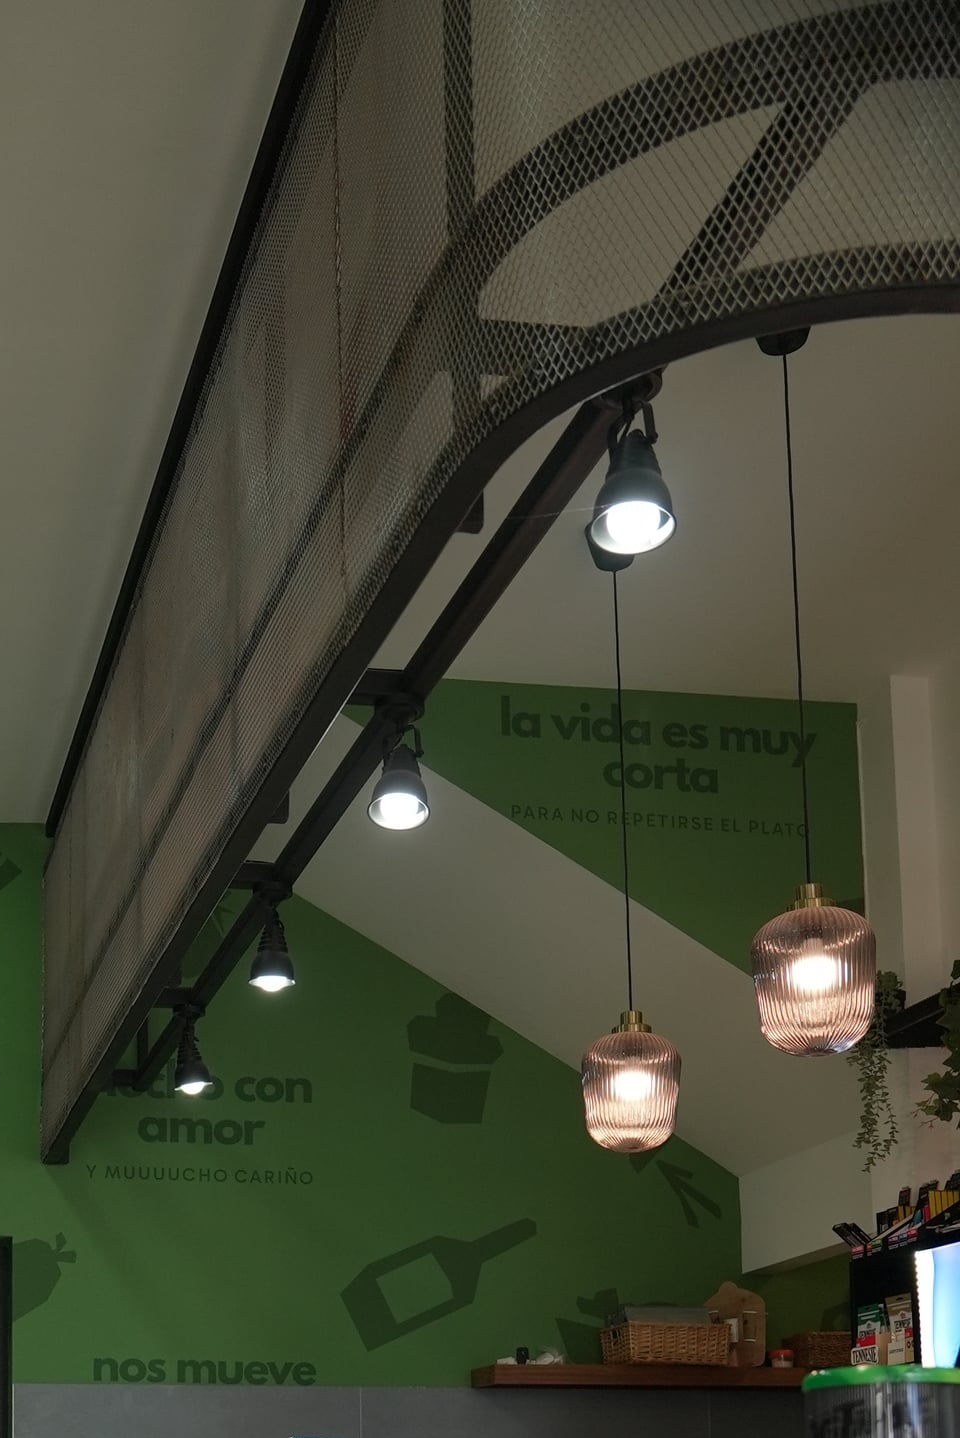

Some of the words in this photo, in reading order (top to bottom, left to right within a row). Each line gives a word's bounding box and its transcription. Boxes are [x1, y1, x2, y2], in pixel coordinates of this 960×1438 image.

[501, 696, 541, 739] la
[551, 703, 651, 746] vida
[662, 721, 709, 750] es
[720, 723, 818, 768] muy
[603, 757, 719, 794] corta
[511, 804, 564, 823] PARA
[572, 808, 600, 825] NO
[607, 810, 714, 832] REPETIRSE
[721, 818, 741, 833] EL
[748, 820, 809, 839] PLATO
[234, 1075, 313, 1103] con
[137, 1115, 267, 1146] amor
[86, 1165, 97, 1179] Y
[104, 1165, 228, 1183] MUUUUCHO
[234, 1167, 314, 1185] CARIÑO
[93, 1356, 166, 1383] nos
[177, 1357, 317, 1386] mueve
